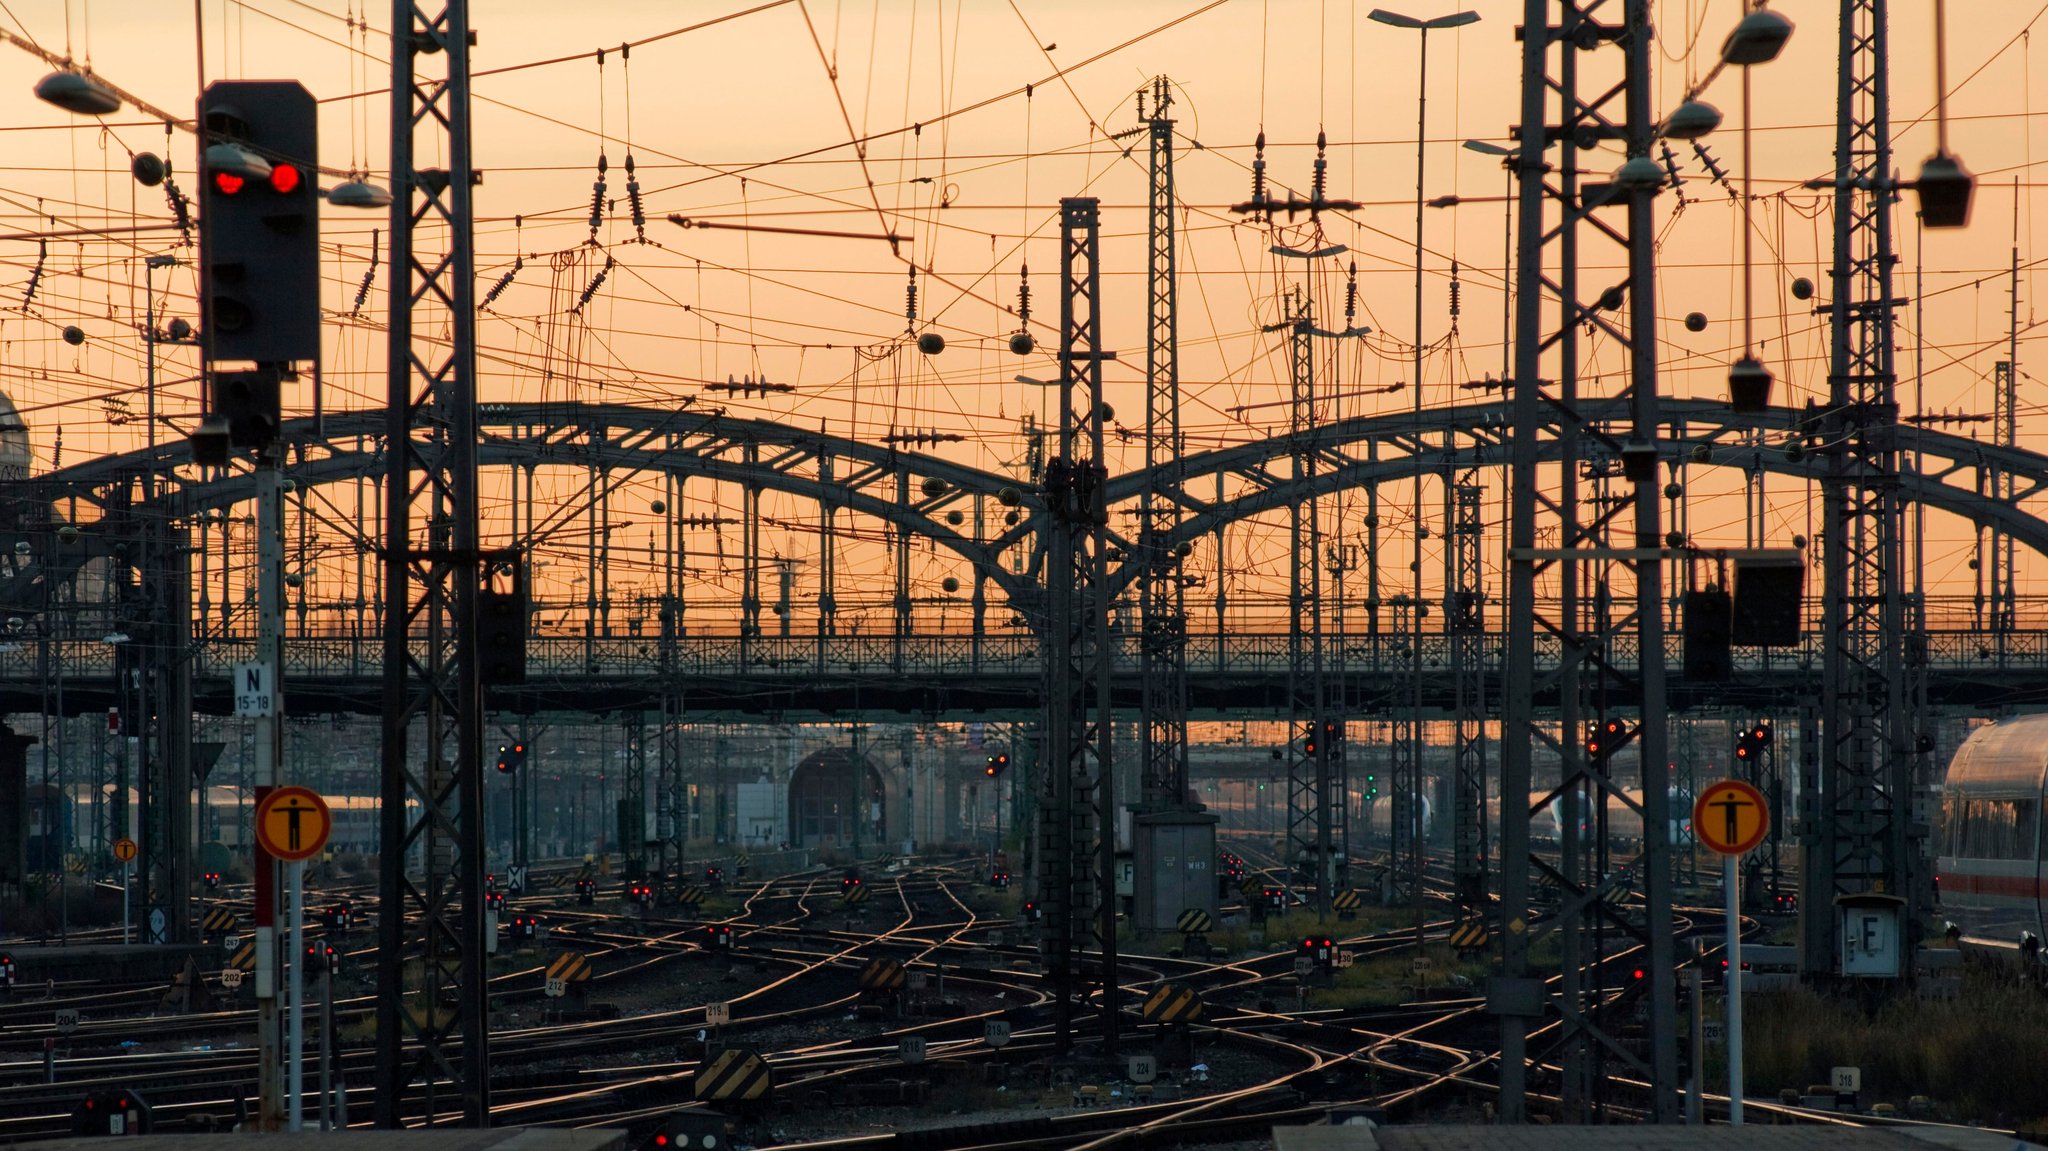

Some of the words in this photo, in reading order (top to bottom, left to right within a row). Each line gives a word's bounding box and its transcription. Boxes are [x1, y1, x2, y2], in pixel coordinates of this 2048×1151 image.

[247, 669, 260, 692] N
[237, 695, 269, 710] 15-18
[1124, 863, 1133, 882] F
[1863, 917, 1878, 950] F
[224, 974, 240, 983] 202
[549, 981, 562, 992] 212
[58, 1015, 77, 1027] 204
[904, 1040, 920, 1054] 218
[1136, 1063, 1149, 1075] 224
[1839, 1074, 1853, 1087] 318
